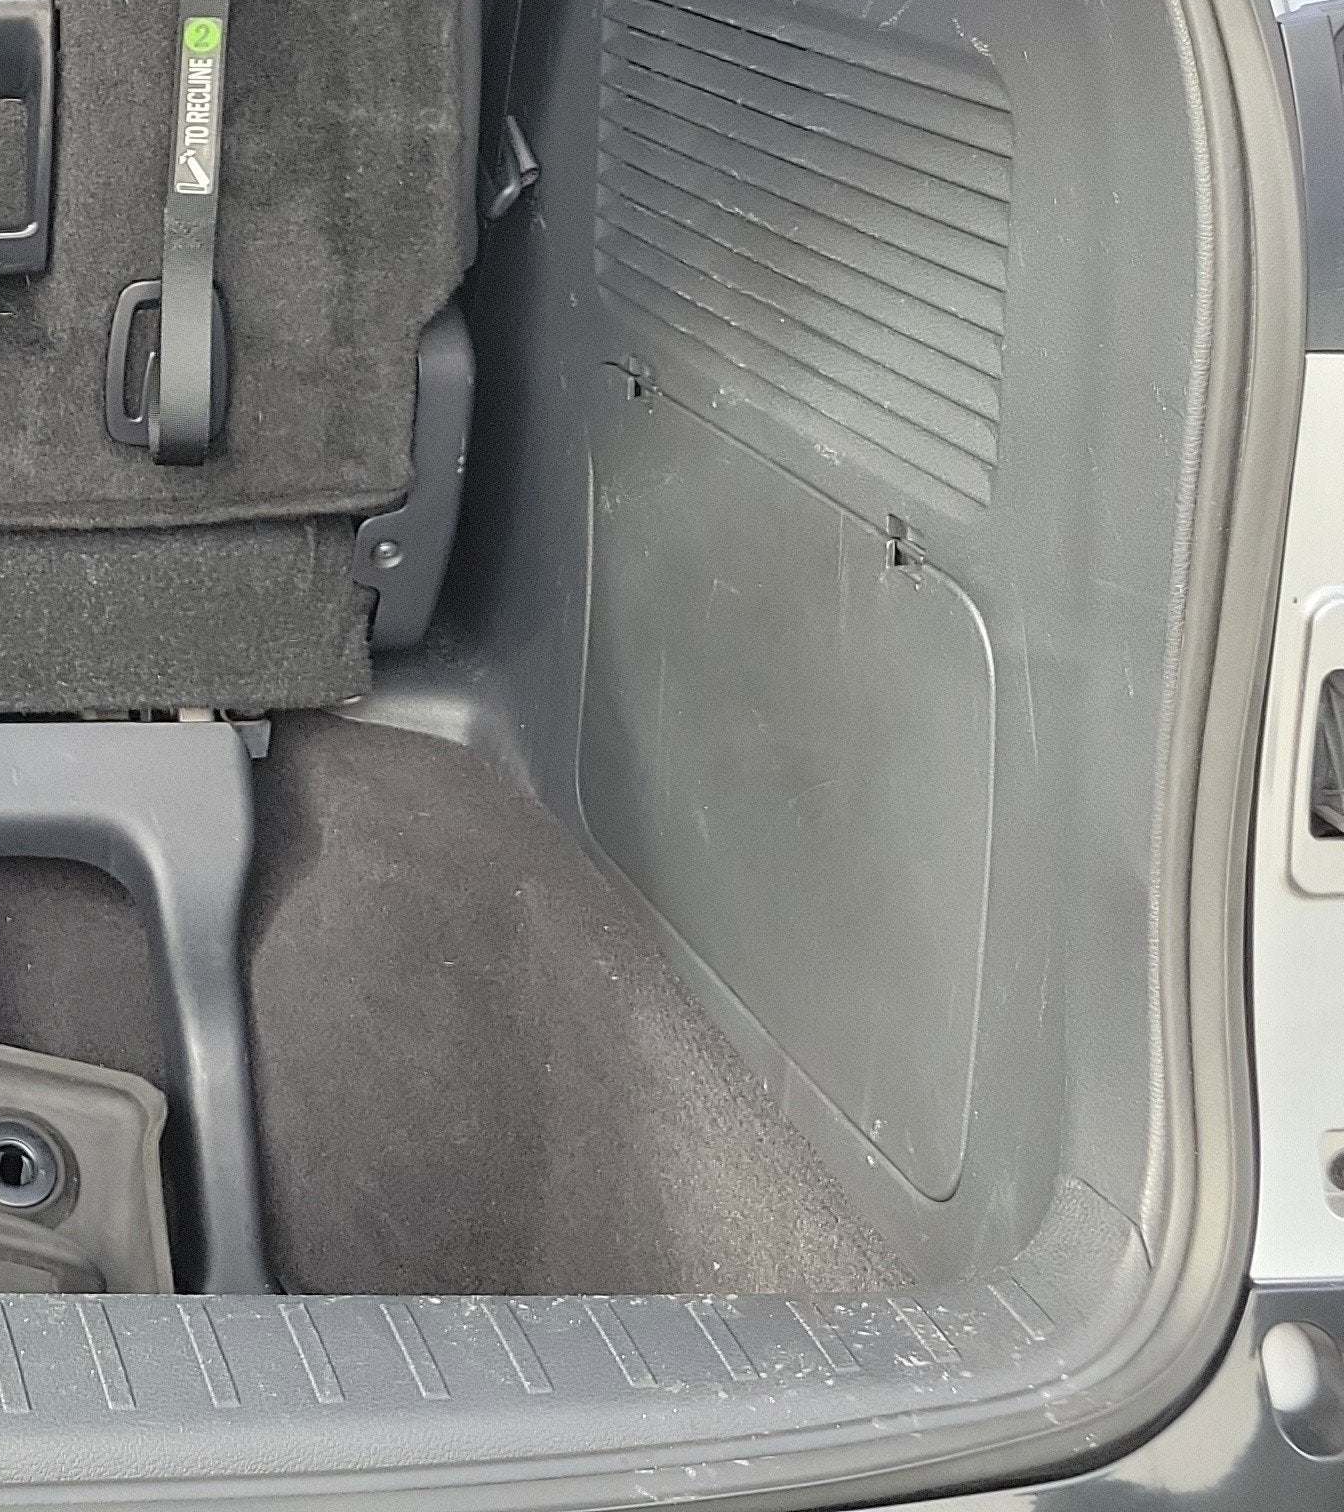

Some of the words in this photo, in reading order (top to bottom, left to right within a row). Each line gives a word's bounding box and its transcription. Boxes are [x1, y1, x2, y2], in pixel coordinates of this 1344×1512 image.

[194, 24, 211, 48] 2
[186, 58, 213, 123] RECLINE
[185, 126, 210, 146] TO
